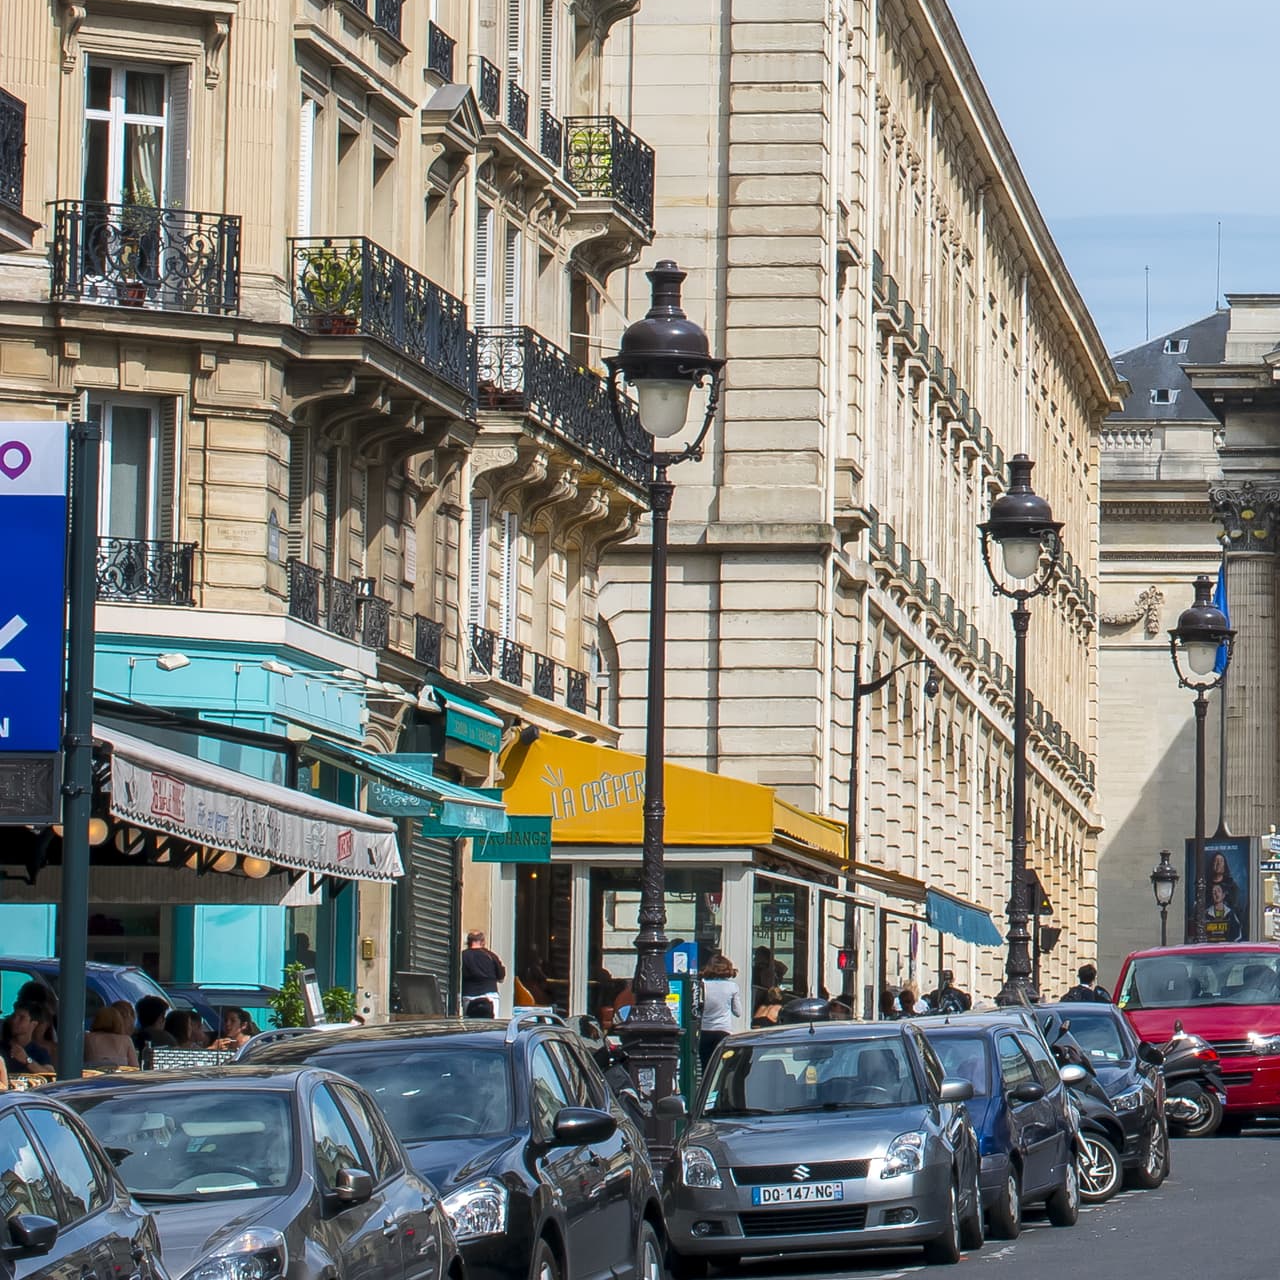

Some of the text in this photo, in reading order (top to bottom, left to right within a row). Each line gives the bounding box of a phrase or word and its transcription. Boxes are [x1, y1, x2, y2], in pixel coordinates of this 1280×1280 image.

[551, 769, 646, 820] LA CRÊPER
[762, 1184, 833, 1202] DQ-147-NG
